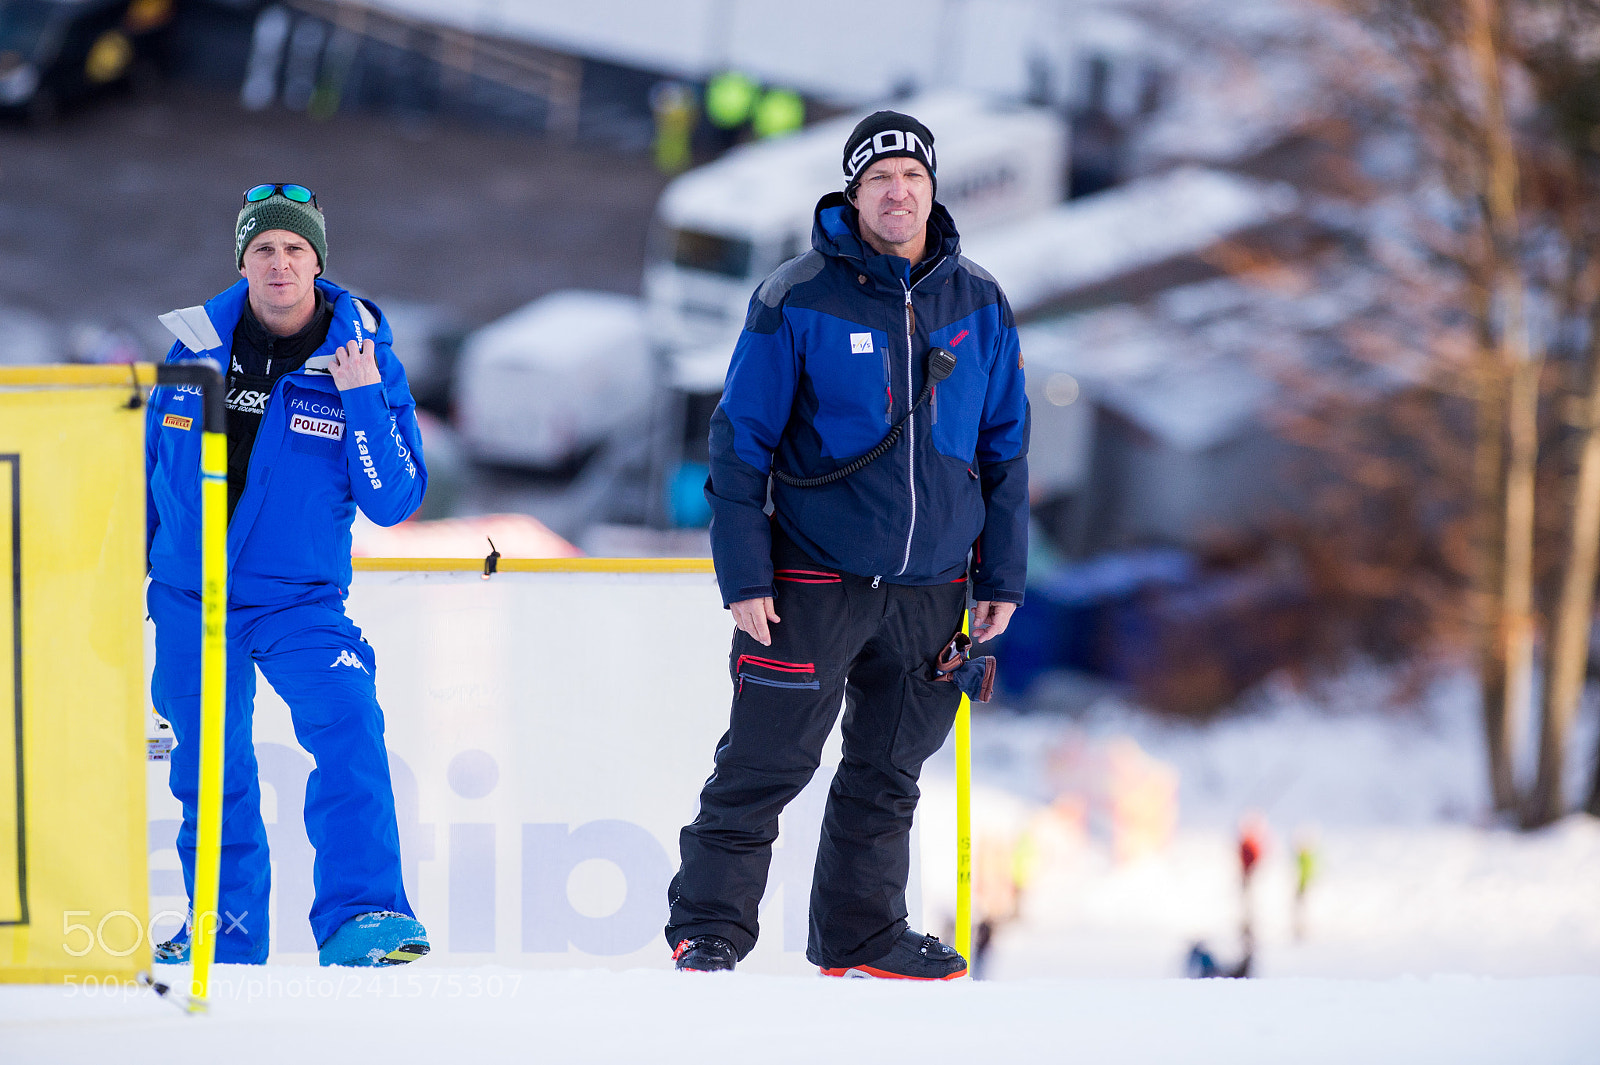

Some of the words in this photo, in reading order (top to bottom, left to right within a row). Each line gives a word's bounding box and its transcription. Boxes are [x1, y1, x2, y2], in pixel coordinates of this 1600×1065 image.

[290, 398, 346, 420] FALCONE
[165, 416, 191, 428] PIRELLI
[293, 417, 340, 437] POLIZIA
[354, 430, 382, 490] Kappa
